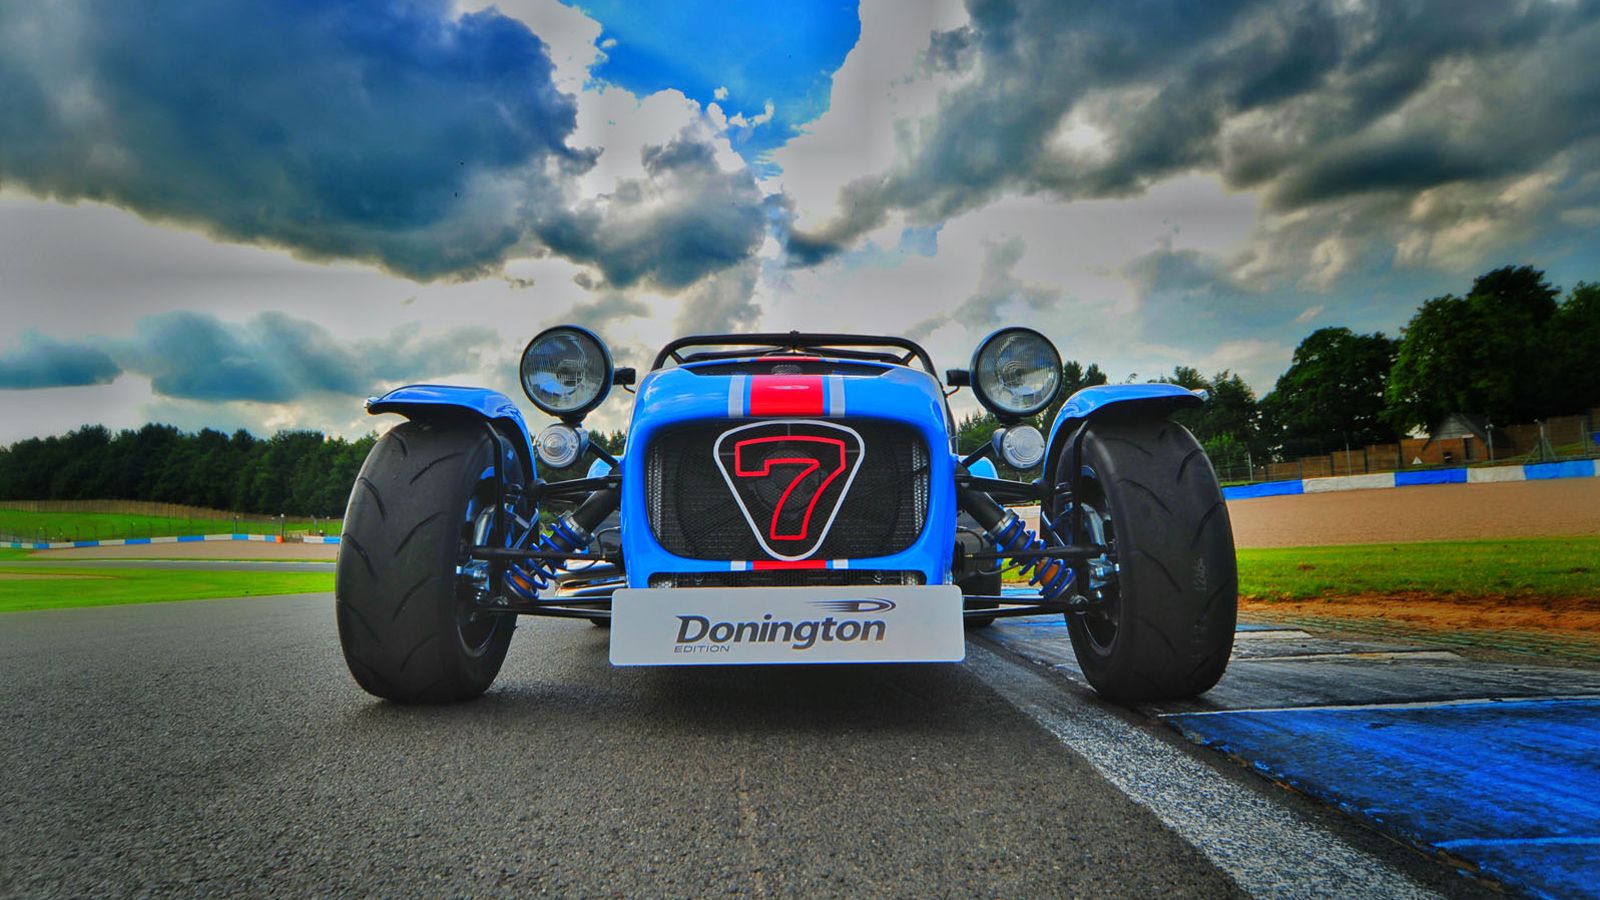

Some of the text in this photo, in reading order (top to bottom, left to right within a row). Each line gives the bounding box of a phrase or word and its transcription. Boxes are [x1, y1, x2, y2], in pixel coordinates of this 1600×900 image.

[735, 435, 846, 540] 7
[673, 645, 730, 654] EDITION
[675, 613, 886, 650] Donington
